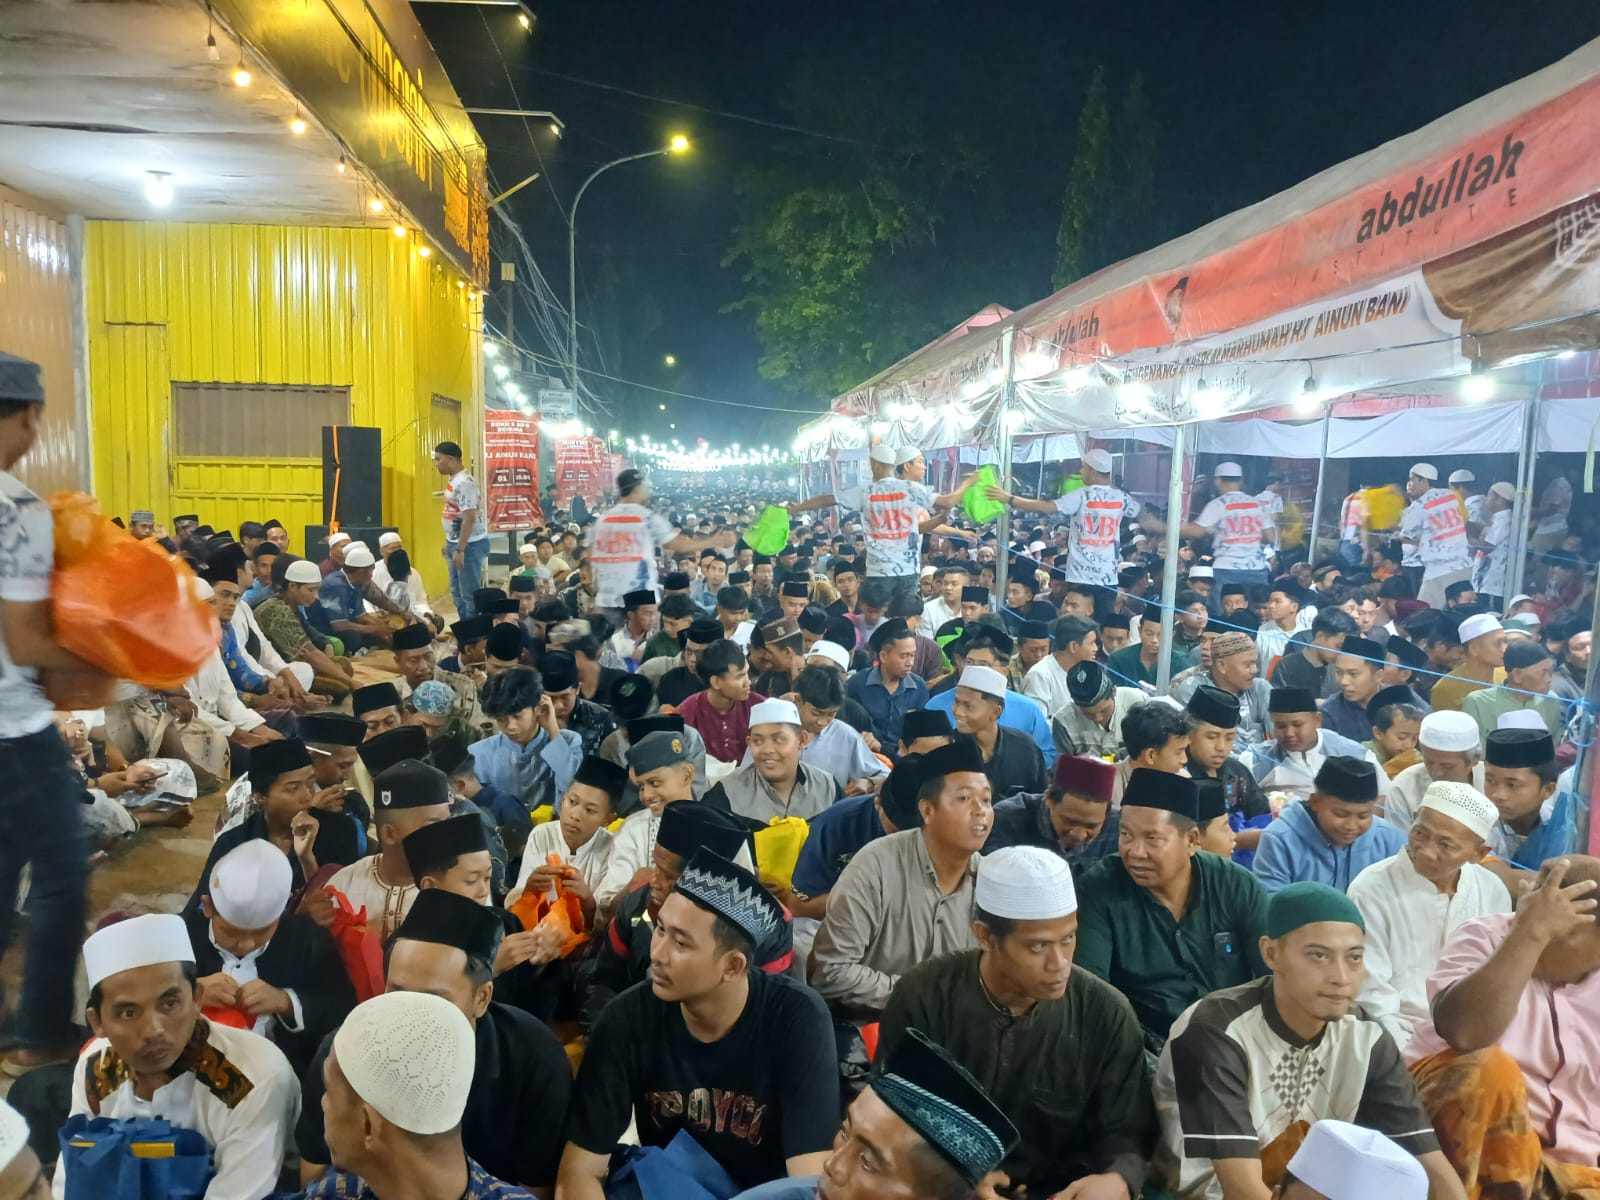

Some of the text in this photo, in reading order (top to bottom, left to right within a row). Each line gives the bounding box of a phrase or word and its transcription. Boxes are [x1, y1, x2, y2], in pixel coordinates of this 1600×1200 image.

[1357, 133, 1525, 244] abdullah
[1313, 298, 1367, 339] AINUN
[1364, 284, 1411, 324] BANI
